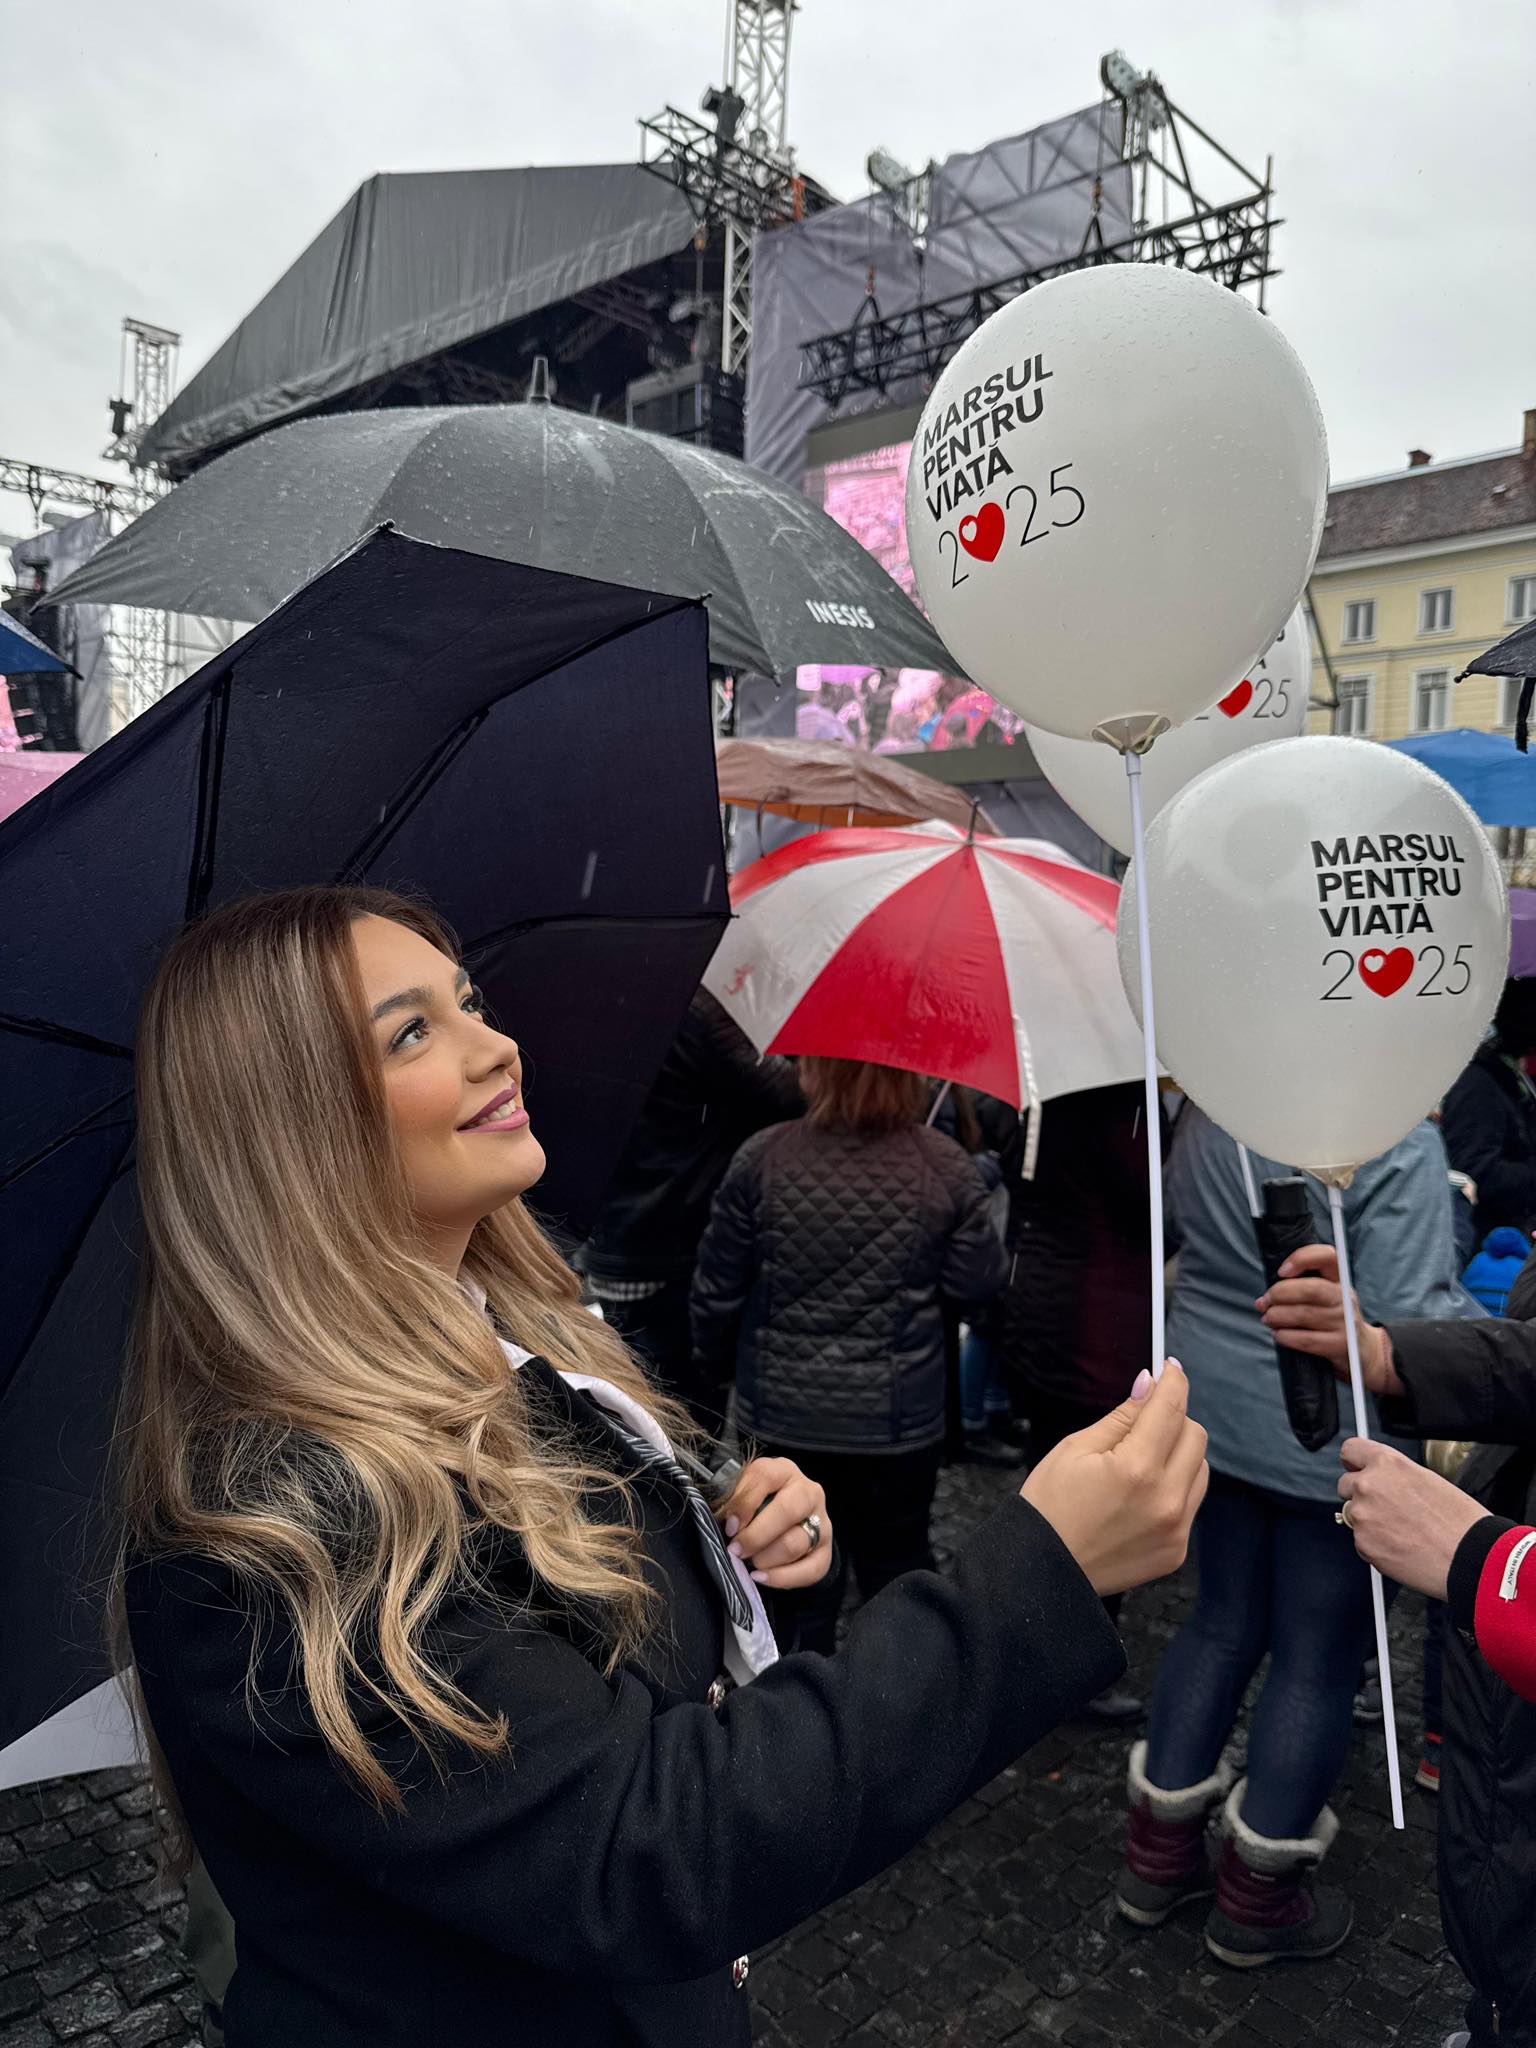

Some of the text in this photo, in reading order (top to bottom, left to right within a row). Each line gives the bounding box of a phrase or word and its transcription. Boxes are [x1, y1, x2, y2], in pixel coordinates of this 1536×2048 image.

[923, 387, 1044, 490] PENTRU
[925, 440, 1014, 522] VIAȚĂ
[1316, 867, 1461, 902] PENTRU
[1318, 897, 1434, 940] VIAȚĂ
[1507, 1567, 1515, 1585] ITALY
